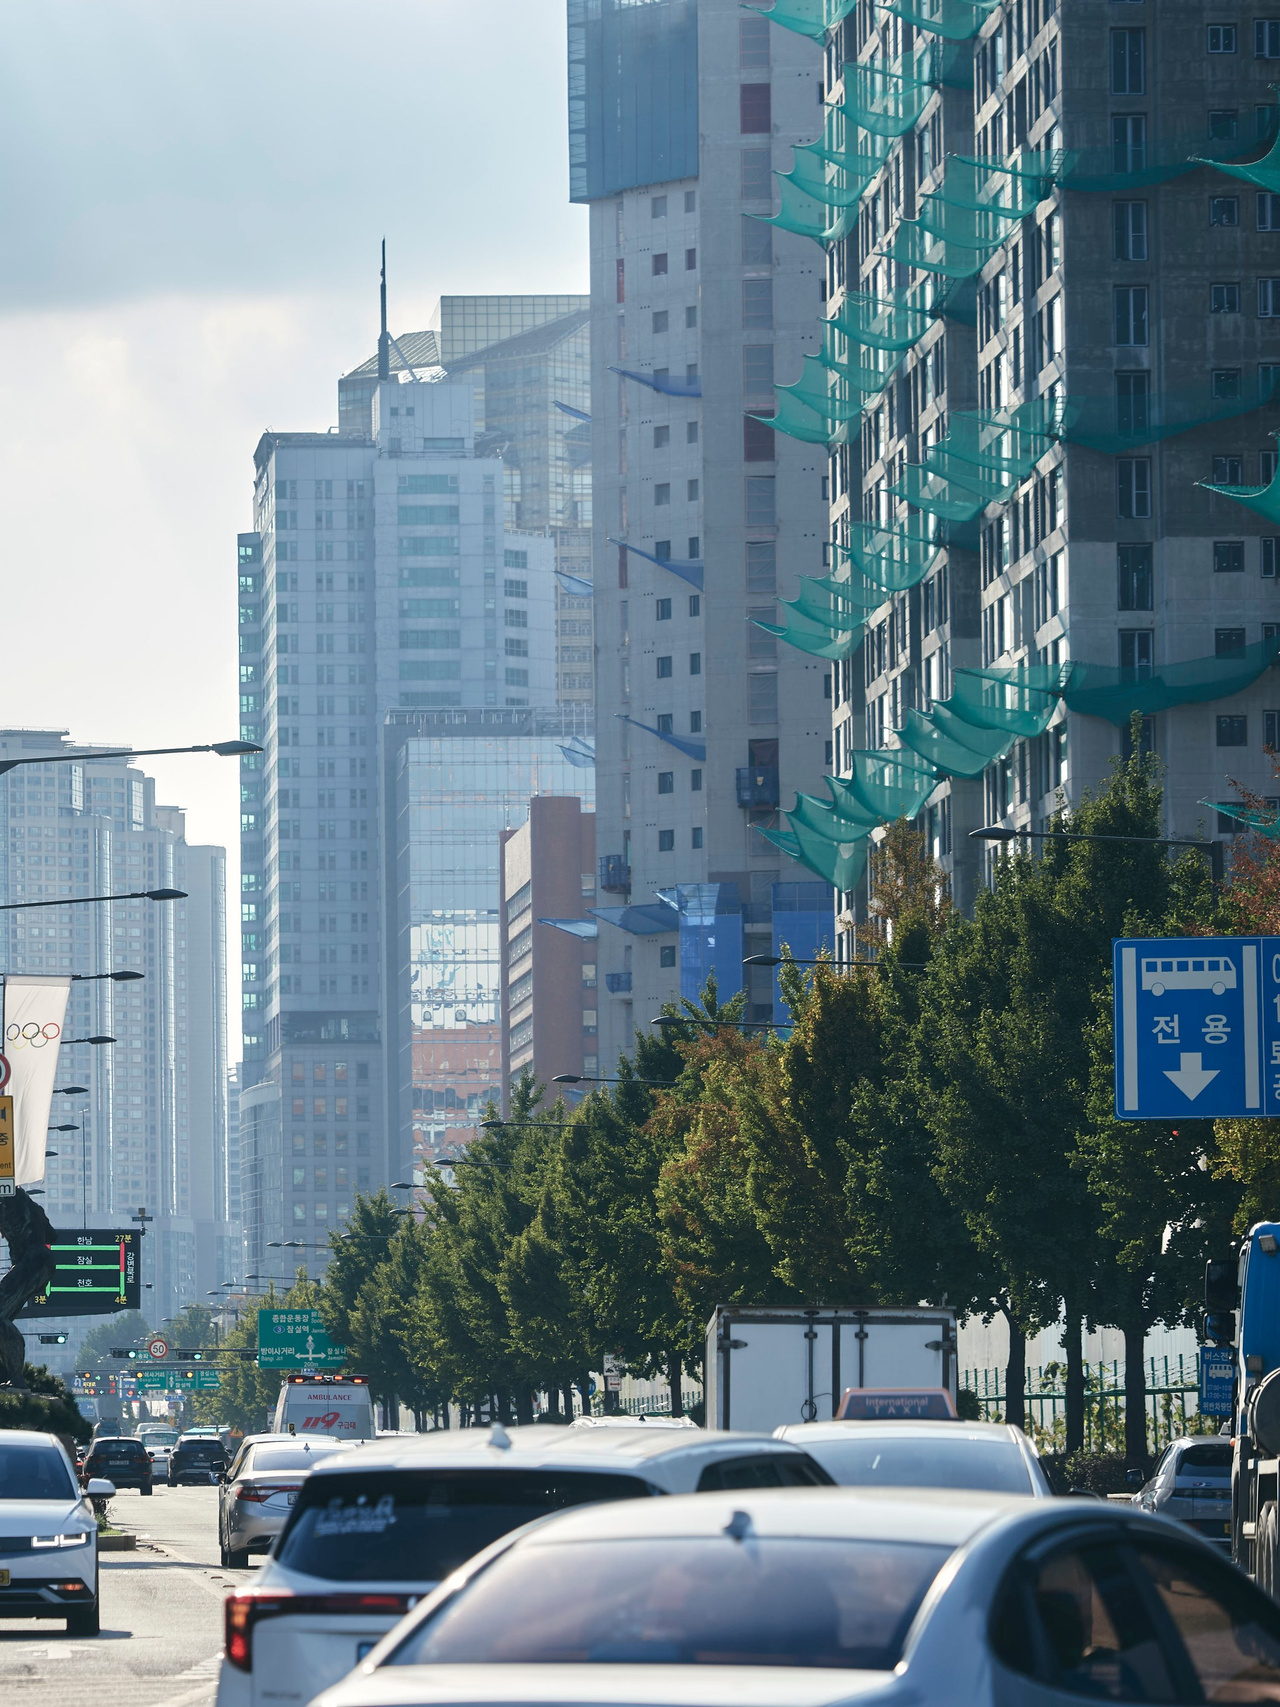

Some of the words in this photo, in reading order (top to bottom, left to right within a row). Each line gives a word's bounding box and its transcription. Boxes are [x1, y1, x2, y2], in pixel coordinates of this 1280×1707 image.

[77, 1236, 93, 1245] 한남
[114, 1234, 132, 1243] 27분
[77, 1256, 93, 1265] 잠실
[77, 1278, 93, 1287] 천호
[34, 1295, 47, 1304] 3분
[114, 1296, 128, 1305] 4분
[272, 1314, 309, 1323] 종합운동장
[286, 1325, 309, 1334] 잠실역
[153, 1345, 164, 1354] 50
[261, 1347, 295, 1355] 방이사거리
[327, 1347, 347, 1355] 잠실나
[866, 1397, 928, 1407] International
[874, 1406, 922, 1414] TAXI
[301, 1412, 341, 1430] 119
[337, 1421, 357, 1430] 구급대
